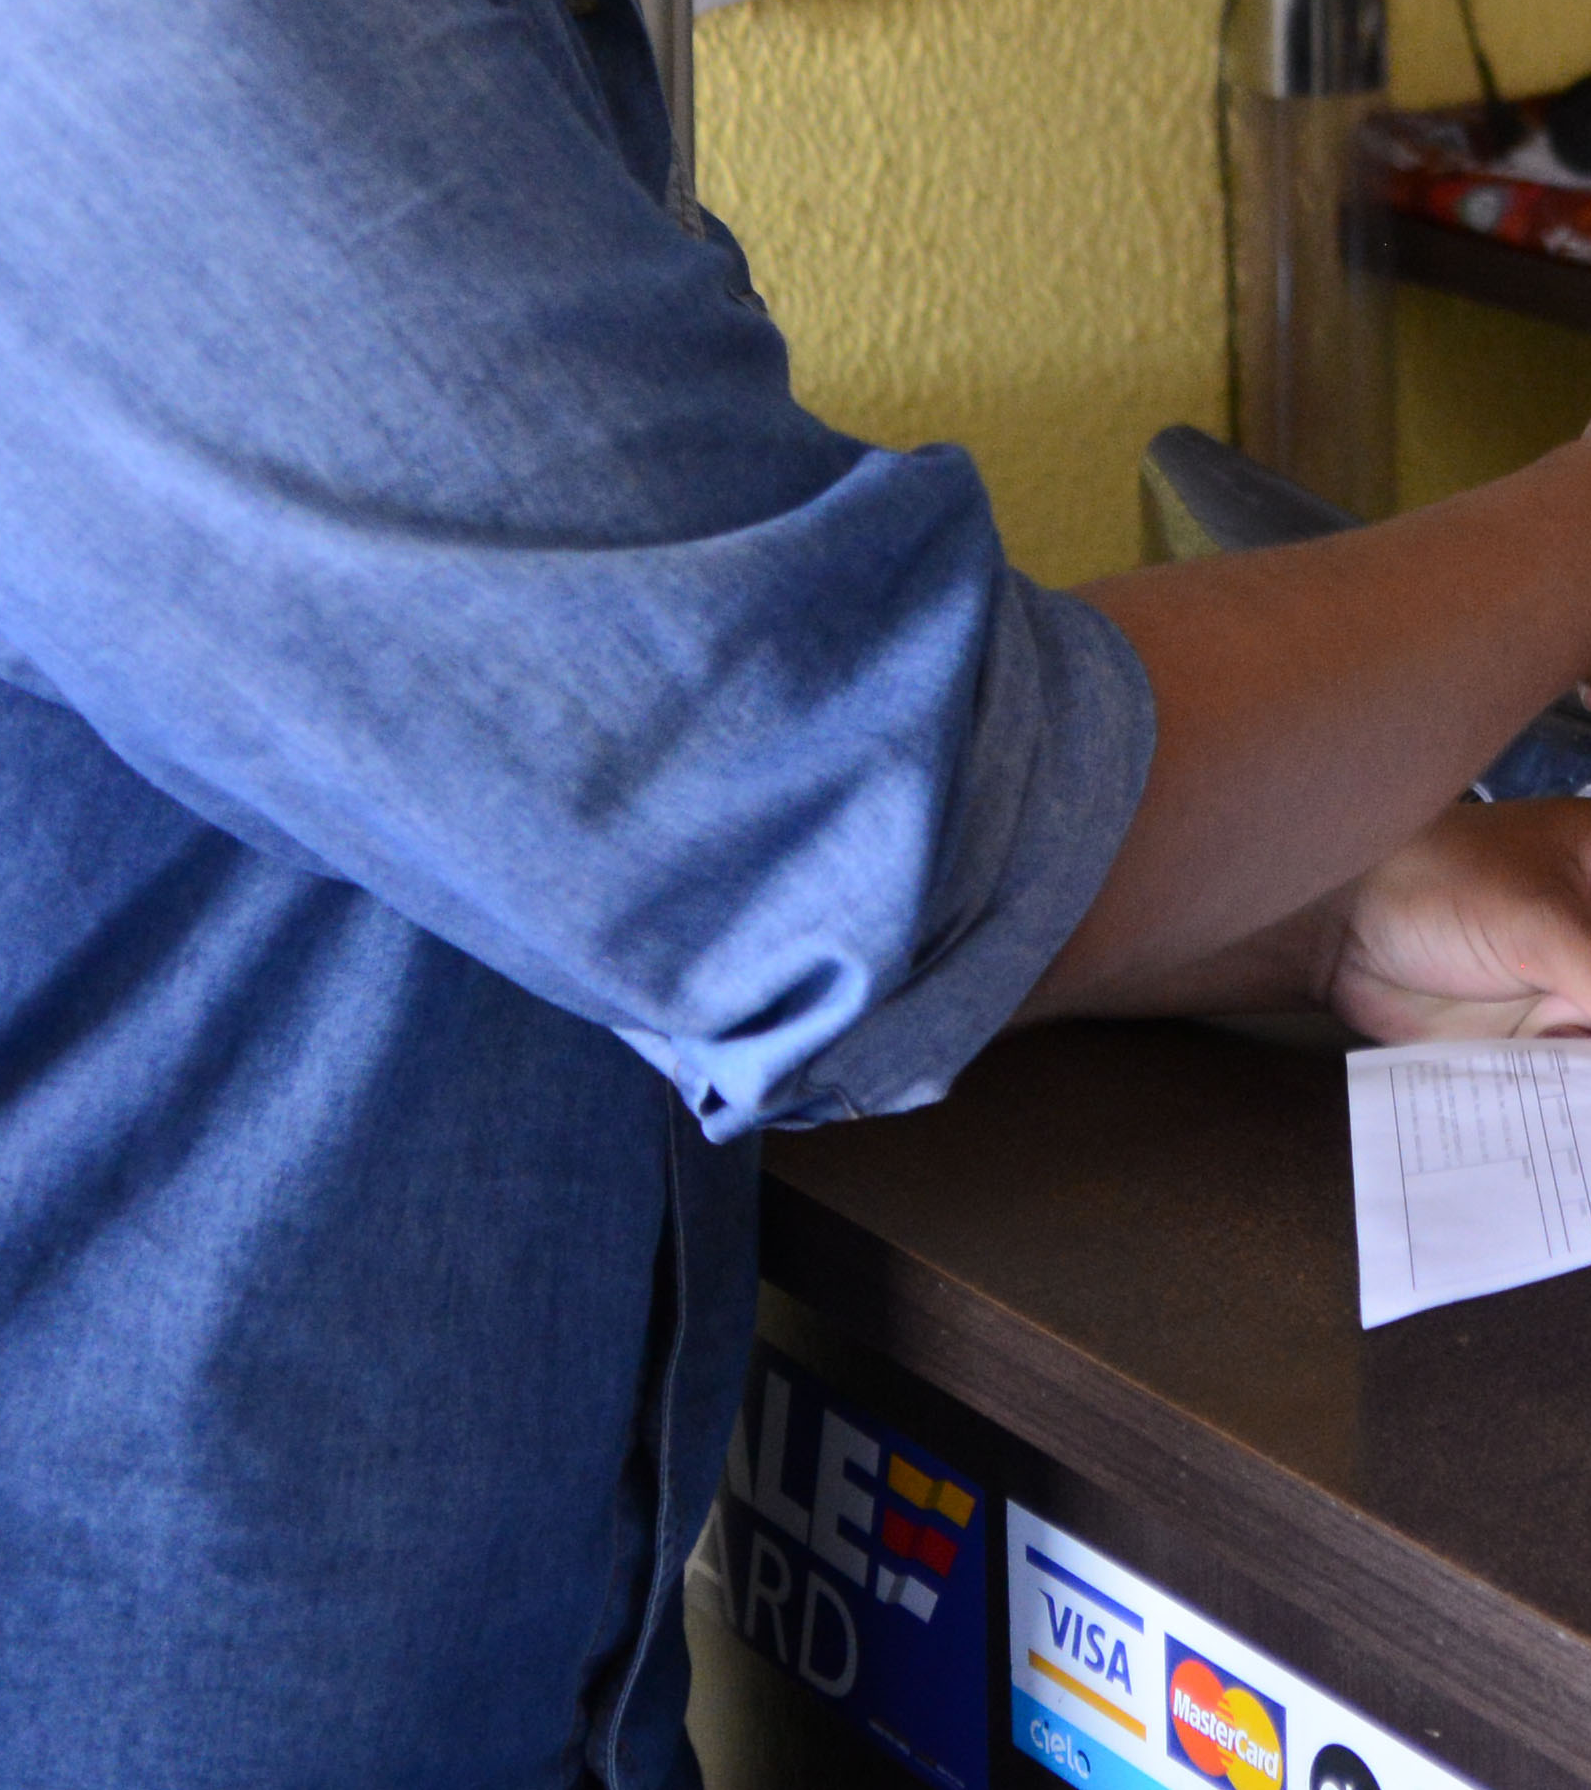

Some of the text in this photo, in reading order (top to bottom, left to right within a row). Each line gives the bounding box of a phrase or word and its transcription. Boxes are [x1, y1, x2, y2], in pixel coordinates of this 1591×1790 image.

[1039, 1588, 1133, 1696] VISA
[1029, 1715, 1092, 1780] cielo
[1173, 1688, 1279, 1781] MasterCard
